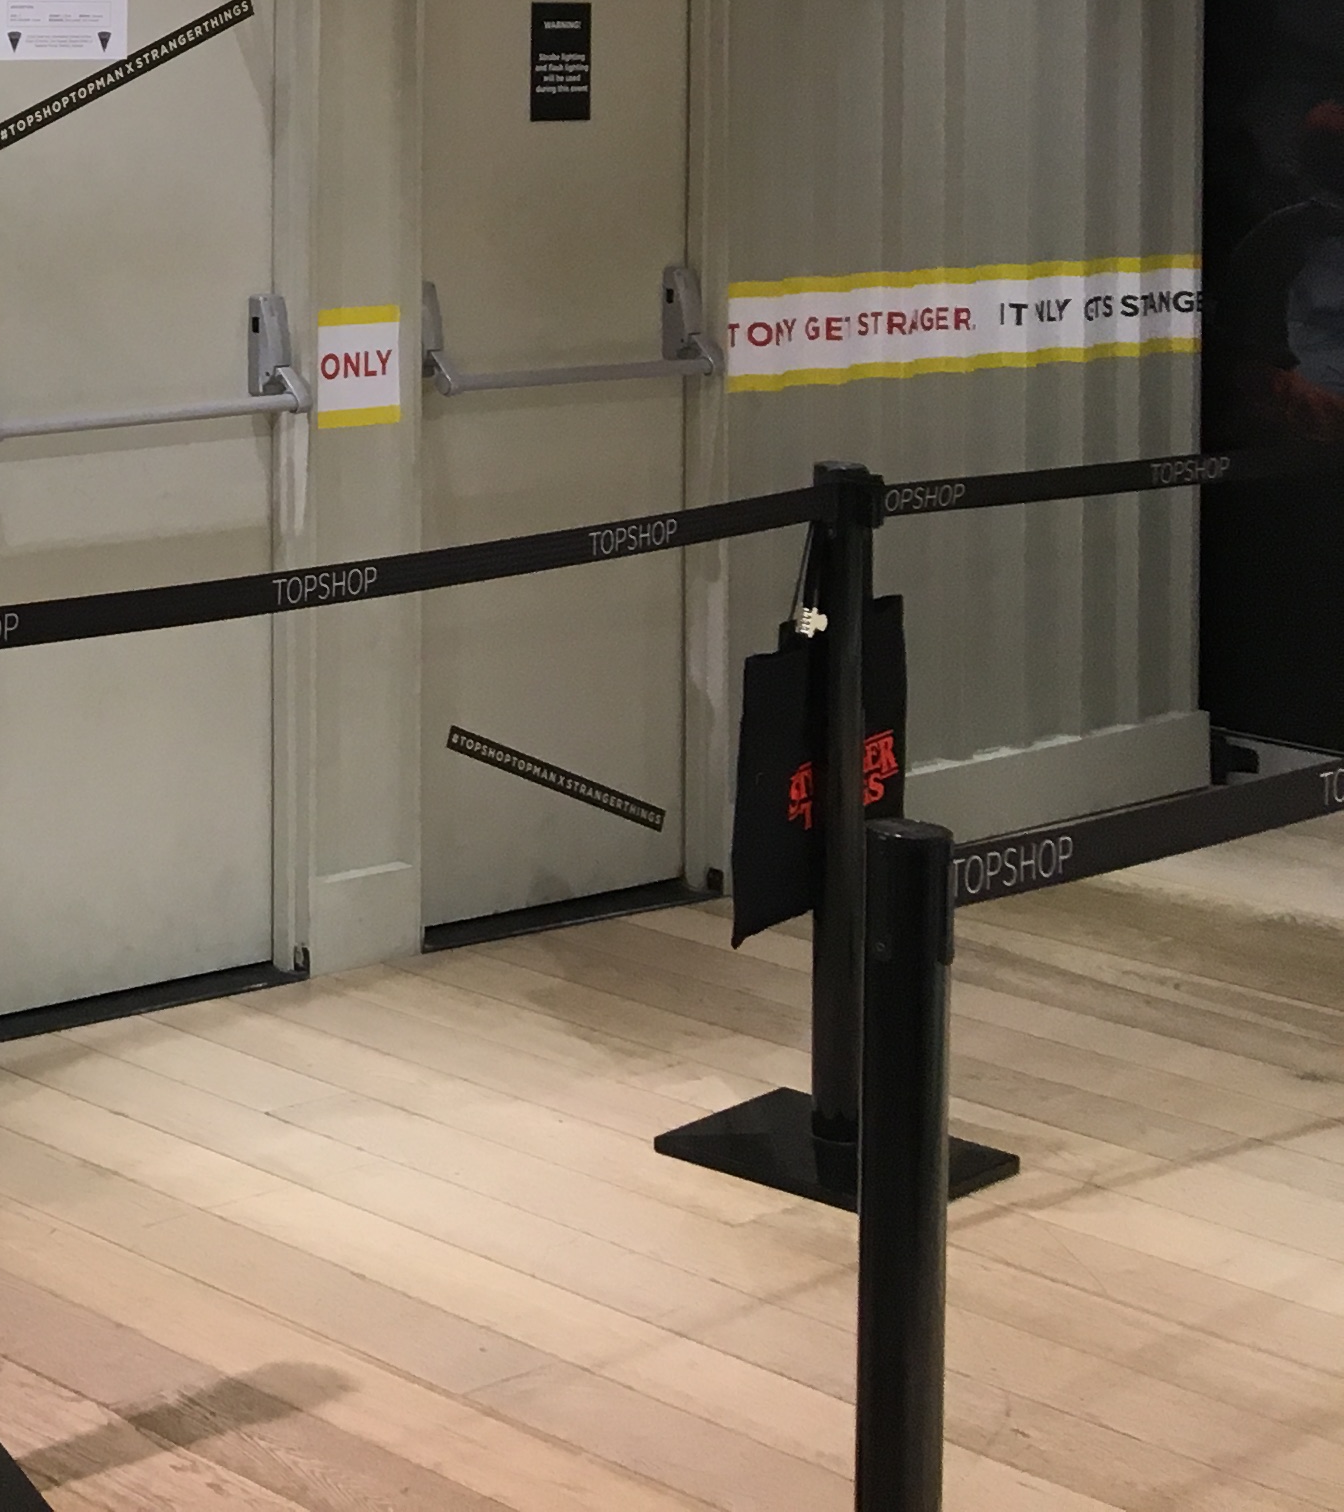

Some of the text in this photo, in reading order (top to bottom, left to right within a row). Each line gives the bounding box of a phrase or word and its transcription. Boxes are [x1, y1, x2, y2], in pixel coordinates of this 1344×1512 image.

[319, 348, 394, 382] ONLY
[1150, 456, 1231, 486] TOPSHOP
[589, 519, 678, 557] TOPSHOP
[272, 566, 378, 607] TOPSHOP
[952, 835, 1074, 899] TOPSHOP
